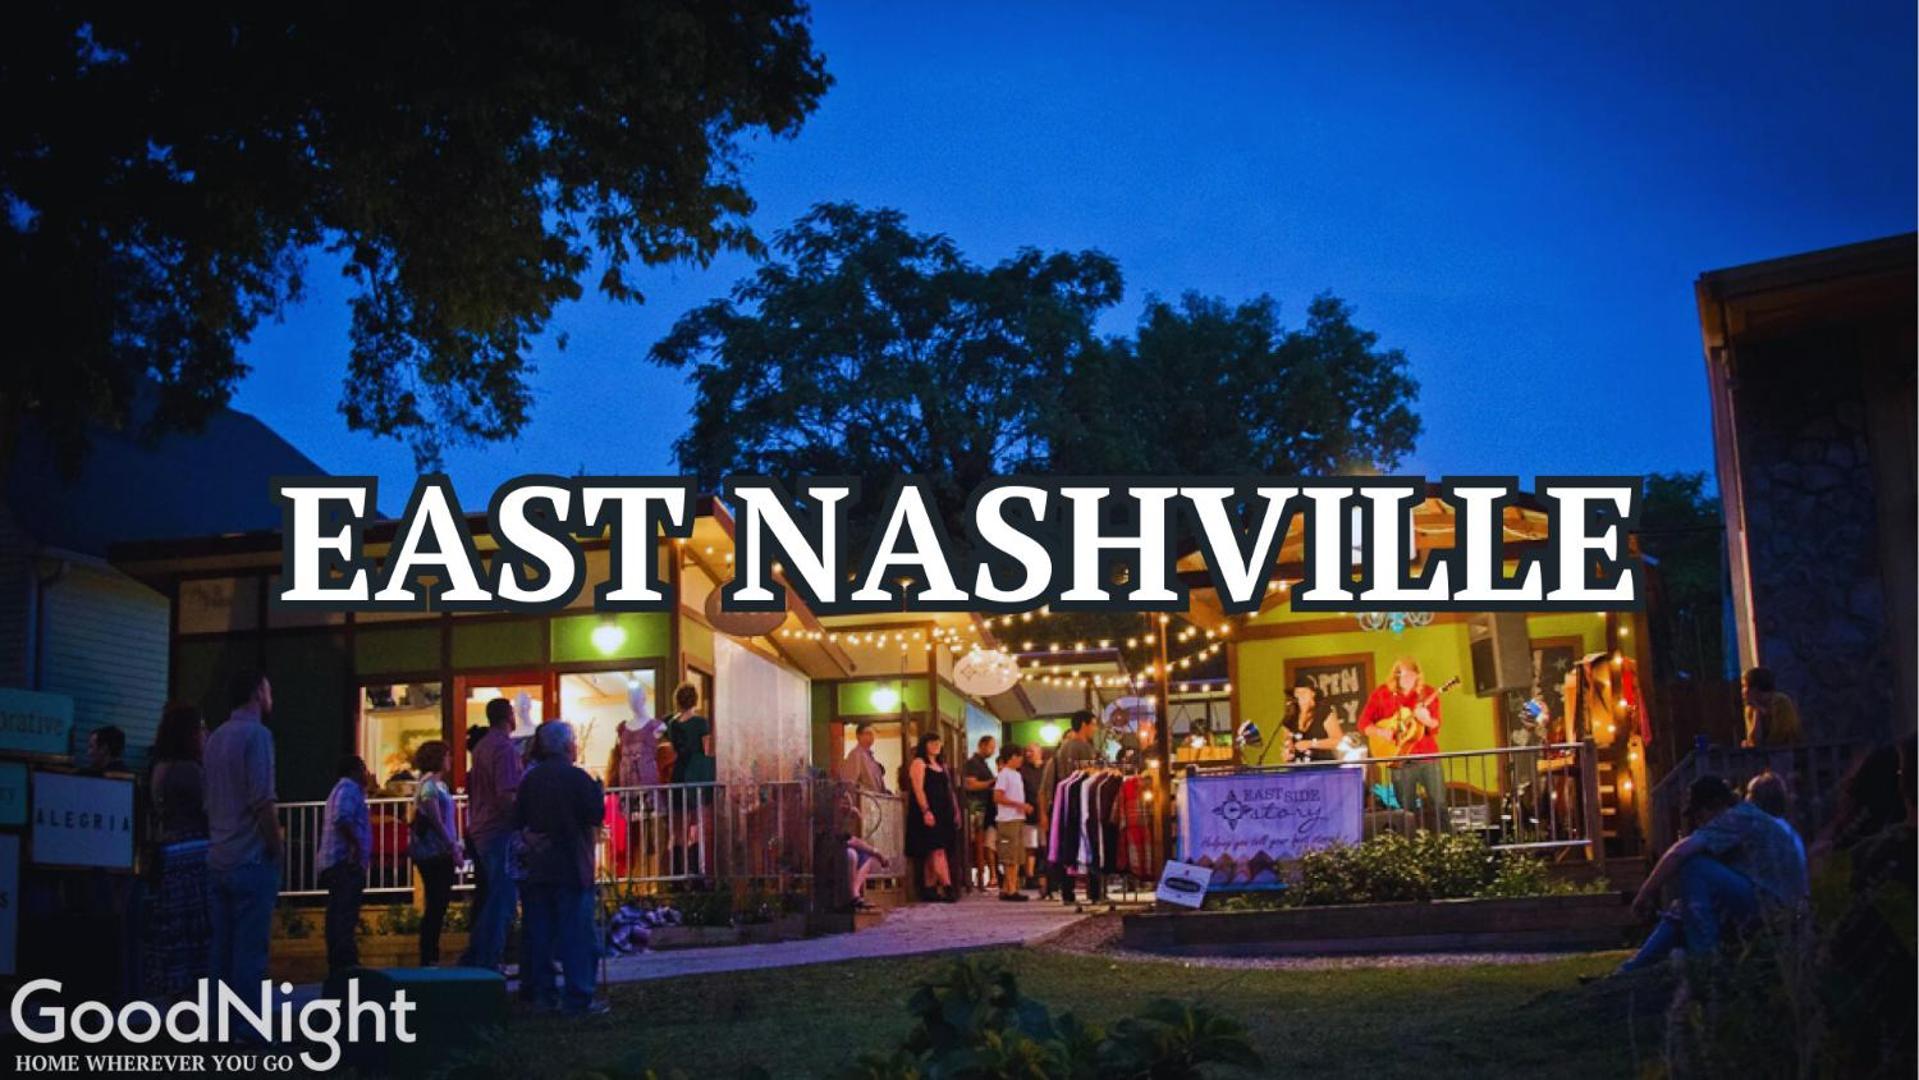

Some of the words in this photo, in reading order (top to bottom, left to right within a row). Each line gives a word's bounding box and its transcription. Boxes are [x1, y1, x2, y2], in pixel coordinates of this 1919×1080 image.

[1243, 787, 1284, 802] EAST
[1284, 788, 1320, 802] SIDE
[37, 807, 129, 832] ALEGRIA
